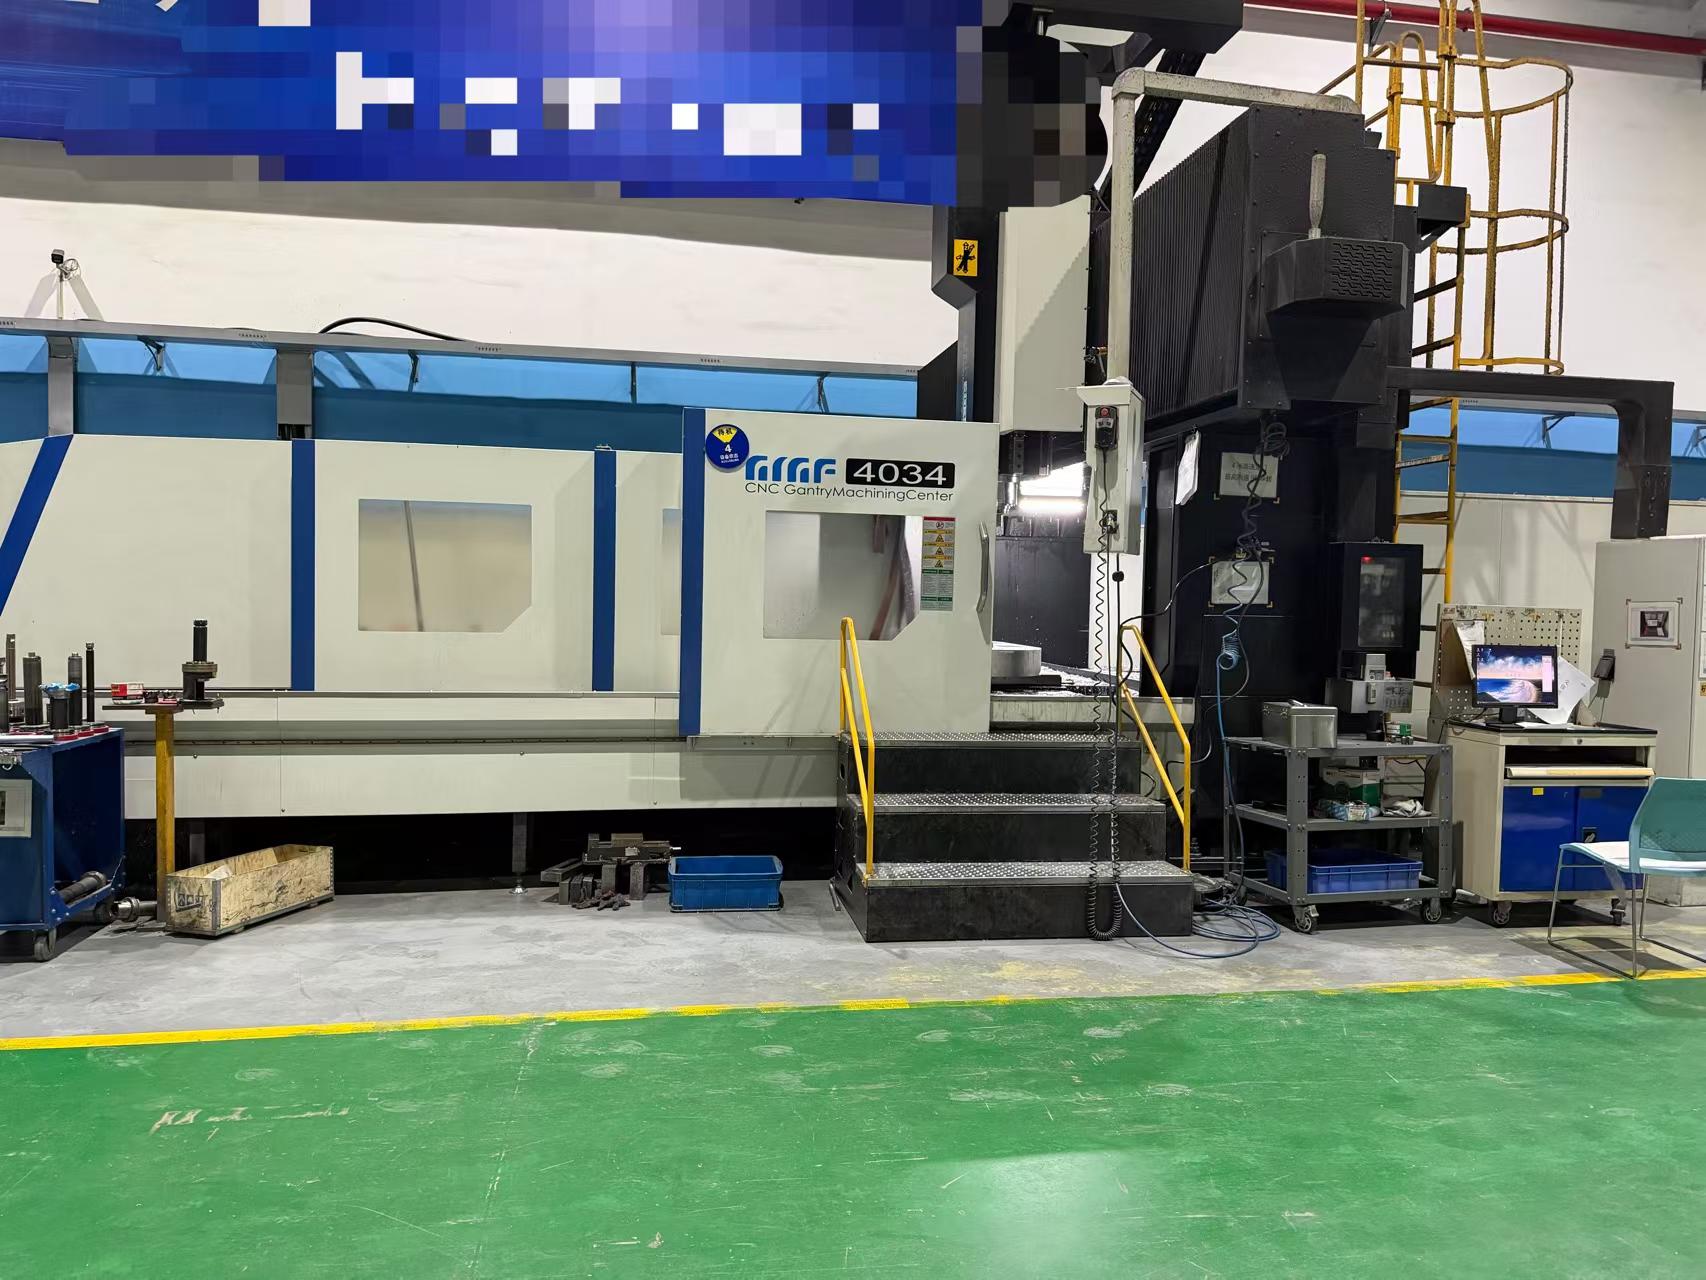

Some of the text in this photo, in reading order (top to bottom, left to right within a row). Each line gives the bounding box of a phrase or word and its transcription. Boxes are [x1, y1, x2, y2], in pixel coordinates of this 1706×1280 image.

[724, 443, 732, 453] 4
[853, 461, 947, 485] 4034
[744, 482, 954, 502] CNC GantryMachiningCenter
